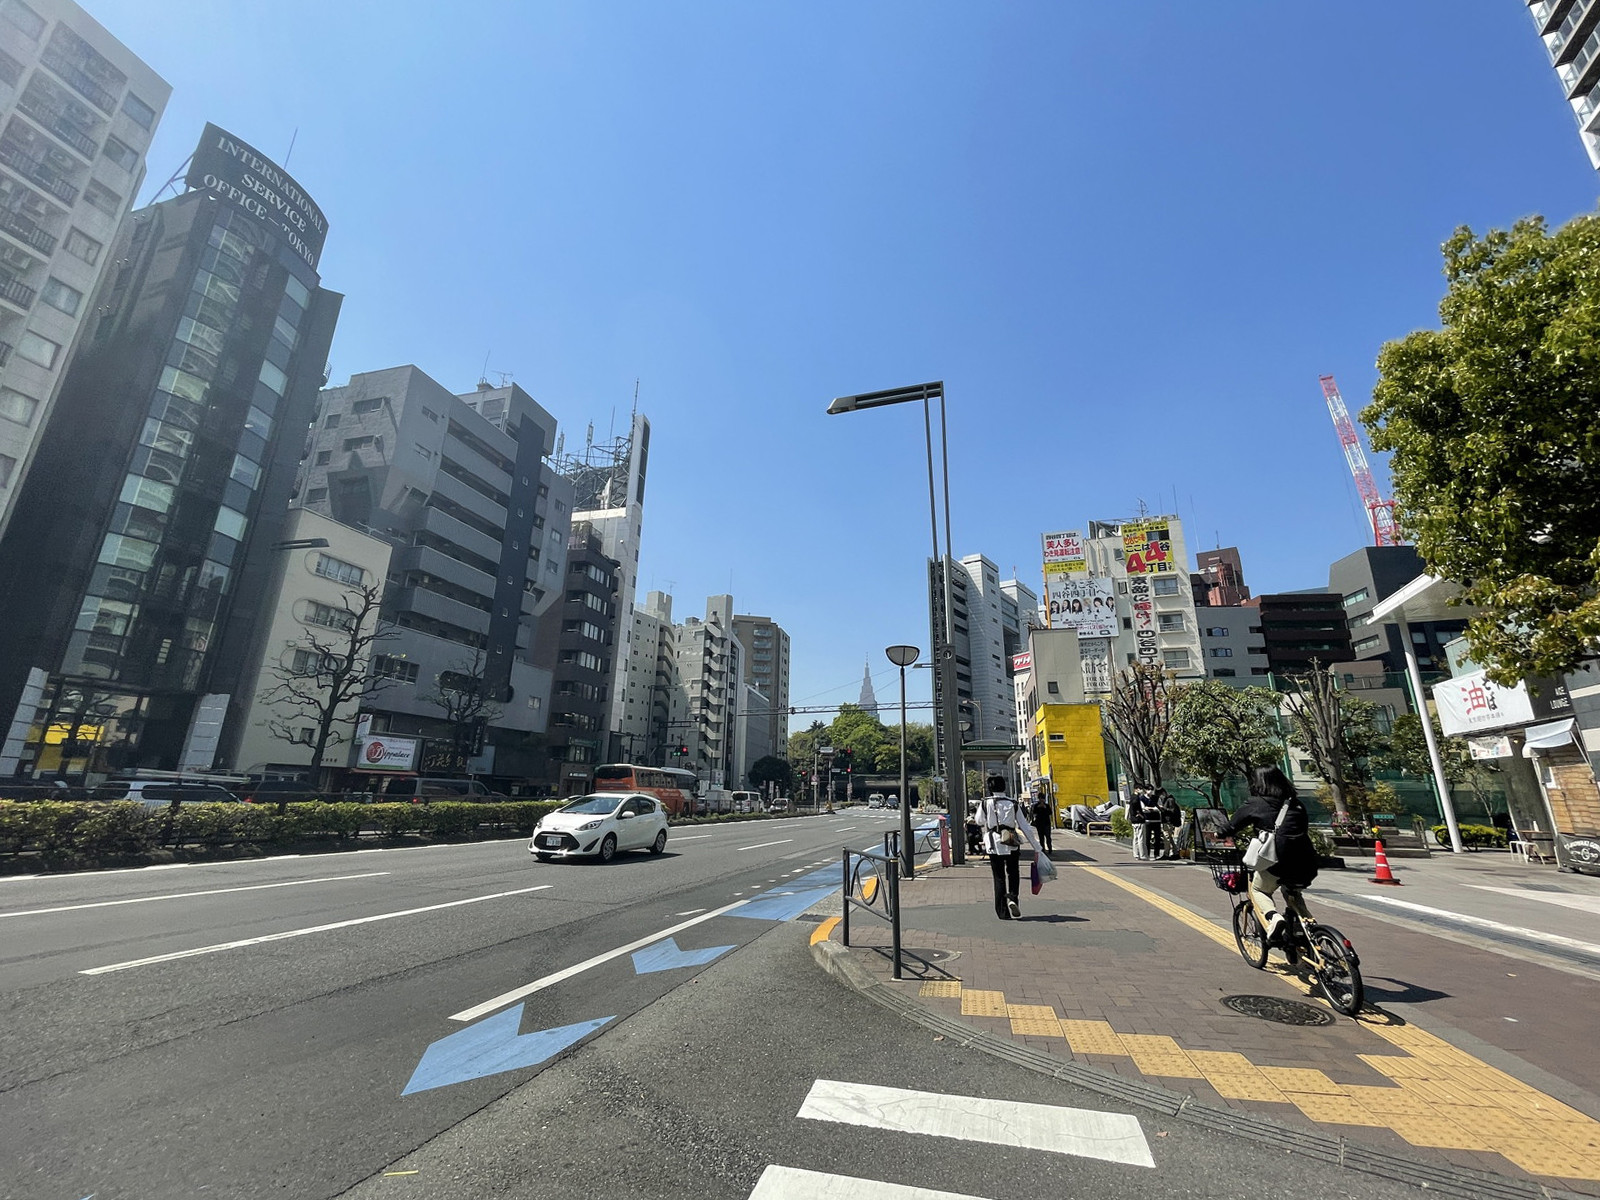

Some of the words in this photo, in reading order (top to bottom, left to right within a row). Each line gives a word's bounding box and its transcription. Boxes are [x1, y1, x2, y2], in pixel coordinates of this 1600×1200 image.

[204, 174, 267, 220] OFFICE
[281, 223, 314, 266] TOKYO
[217, 137, 322, 234] INTERNATIONAL
[241, 173, 307, 232] SERVICE
